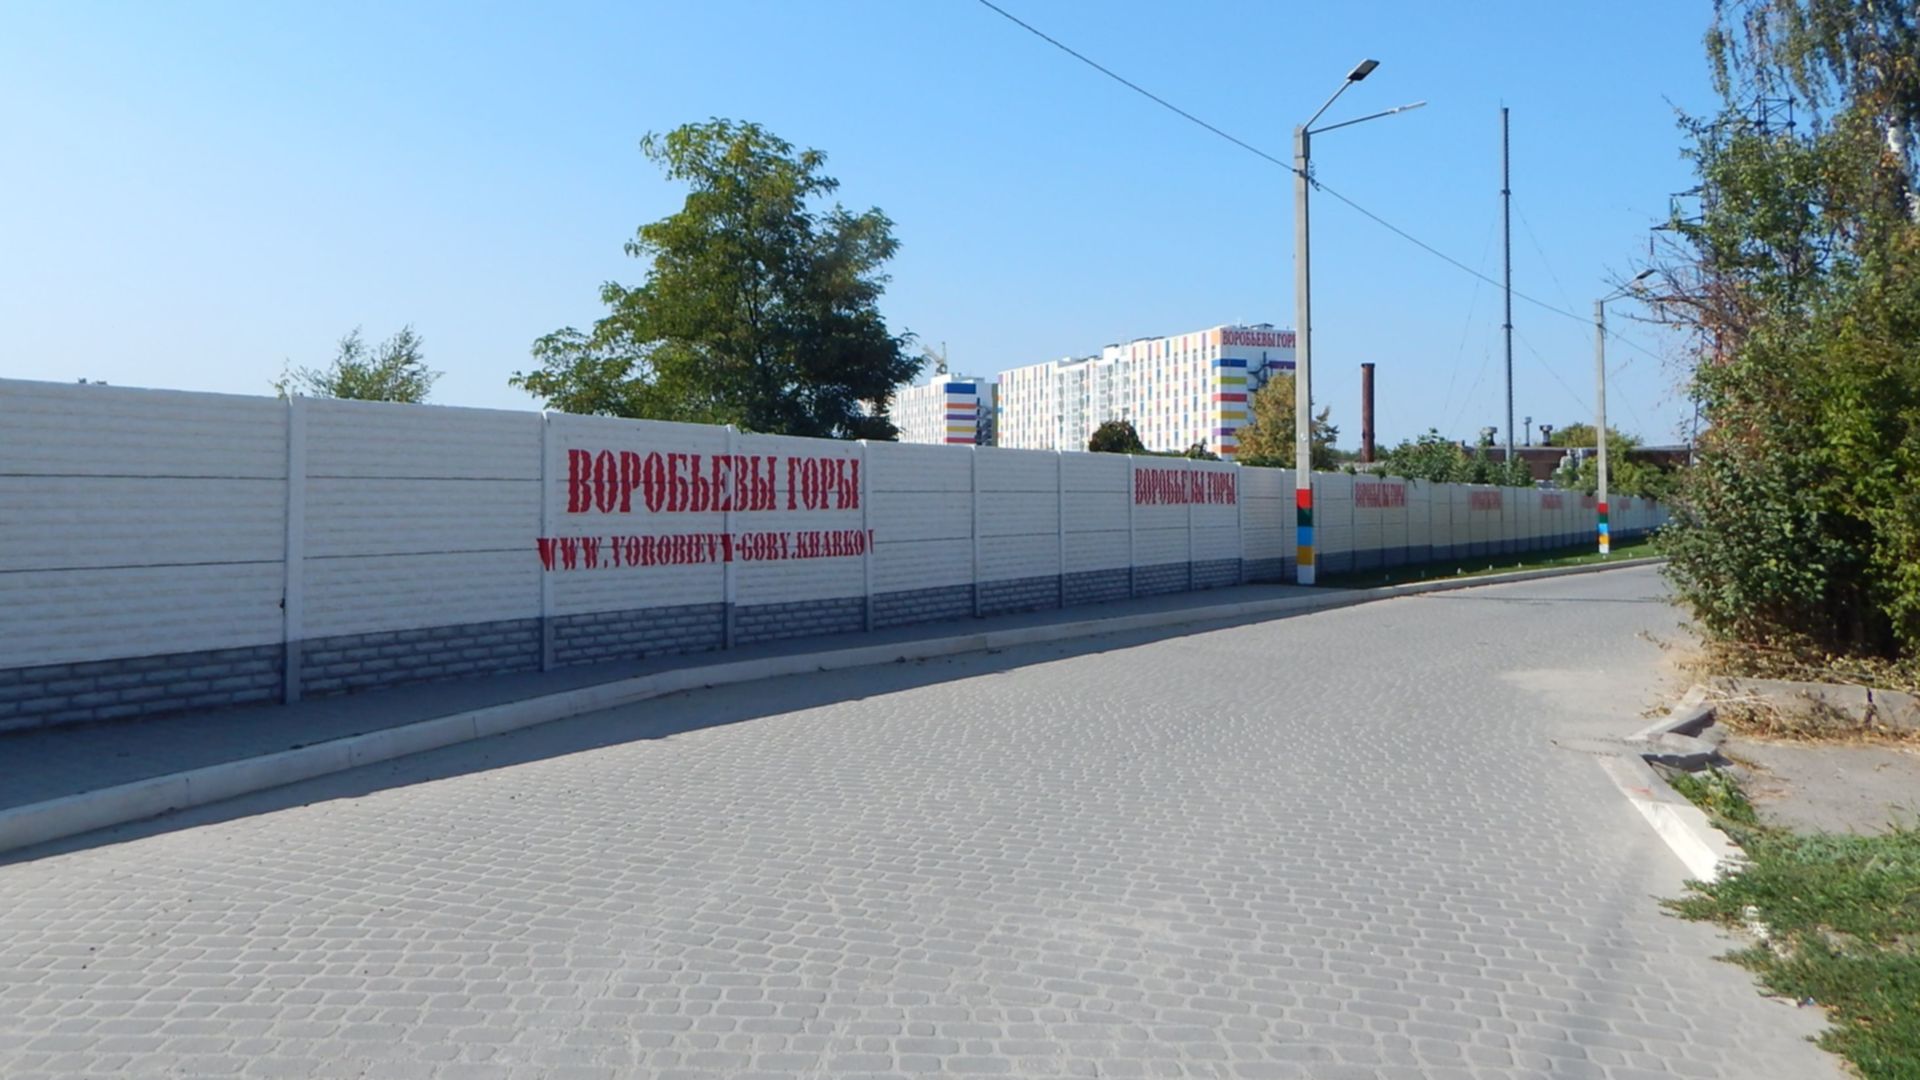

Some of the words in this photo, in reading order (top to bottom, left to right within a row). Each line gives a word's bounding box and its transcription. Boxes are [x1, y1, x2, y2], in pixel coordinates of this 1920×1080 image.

[568, 449, 777, 513] ВОРОБЬЕВЫ
[787, 457, 859, 511] ГОРЫ
[1207, 472, 1236, 505] ГОРЫ
